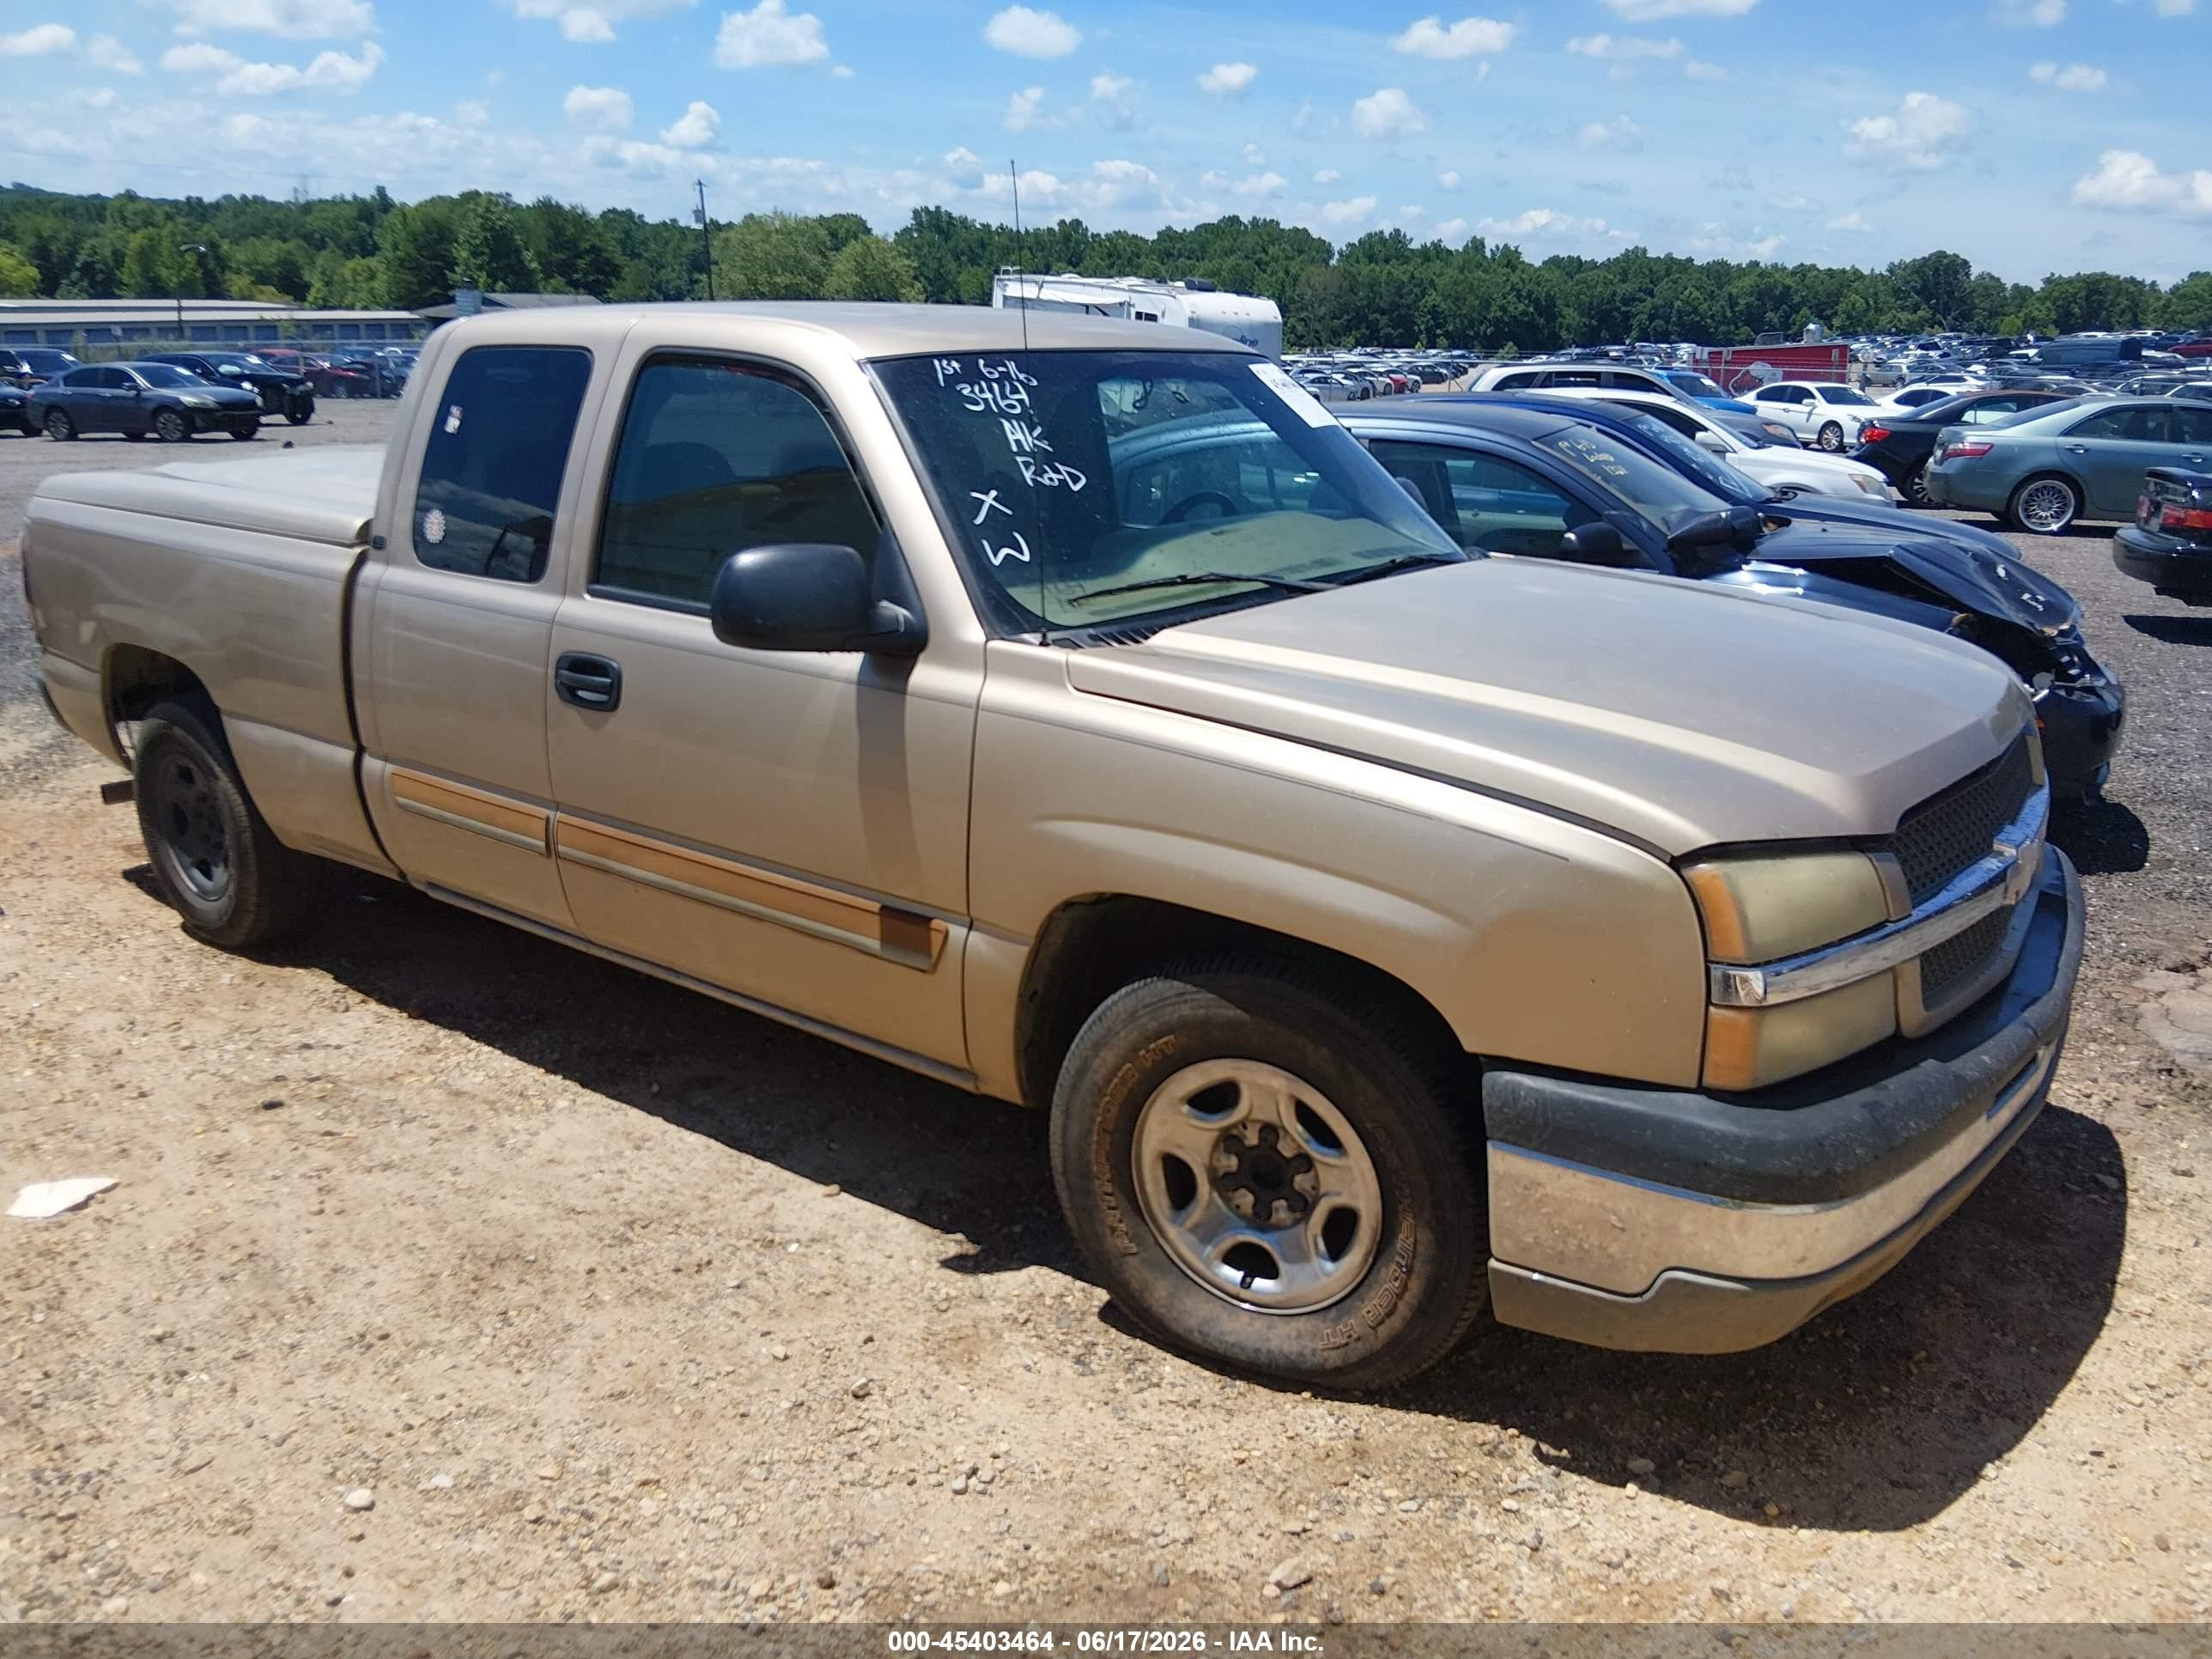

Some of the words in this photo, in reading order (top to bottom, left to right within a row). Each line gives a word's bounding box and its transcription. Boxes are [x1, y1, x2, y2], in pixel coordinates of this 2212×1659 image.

[978, 358, 1037, 386] 6-16
[955, 380, 1030, 414] 3464
[969, 489, 1014, 526] X
[1318, 1318, 1361, 1352] HT
